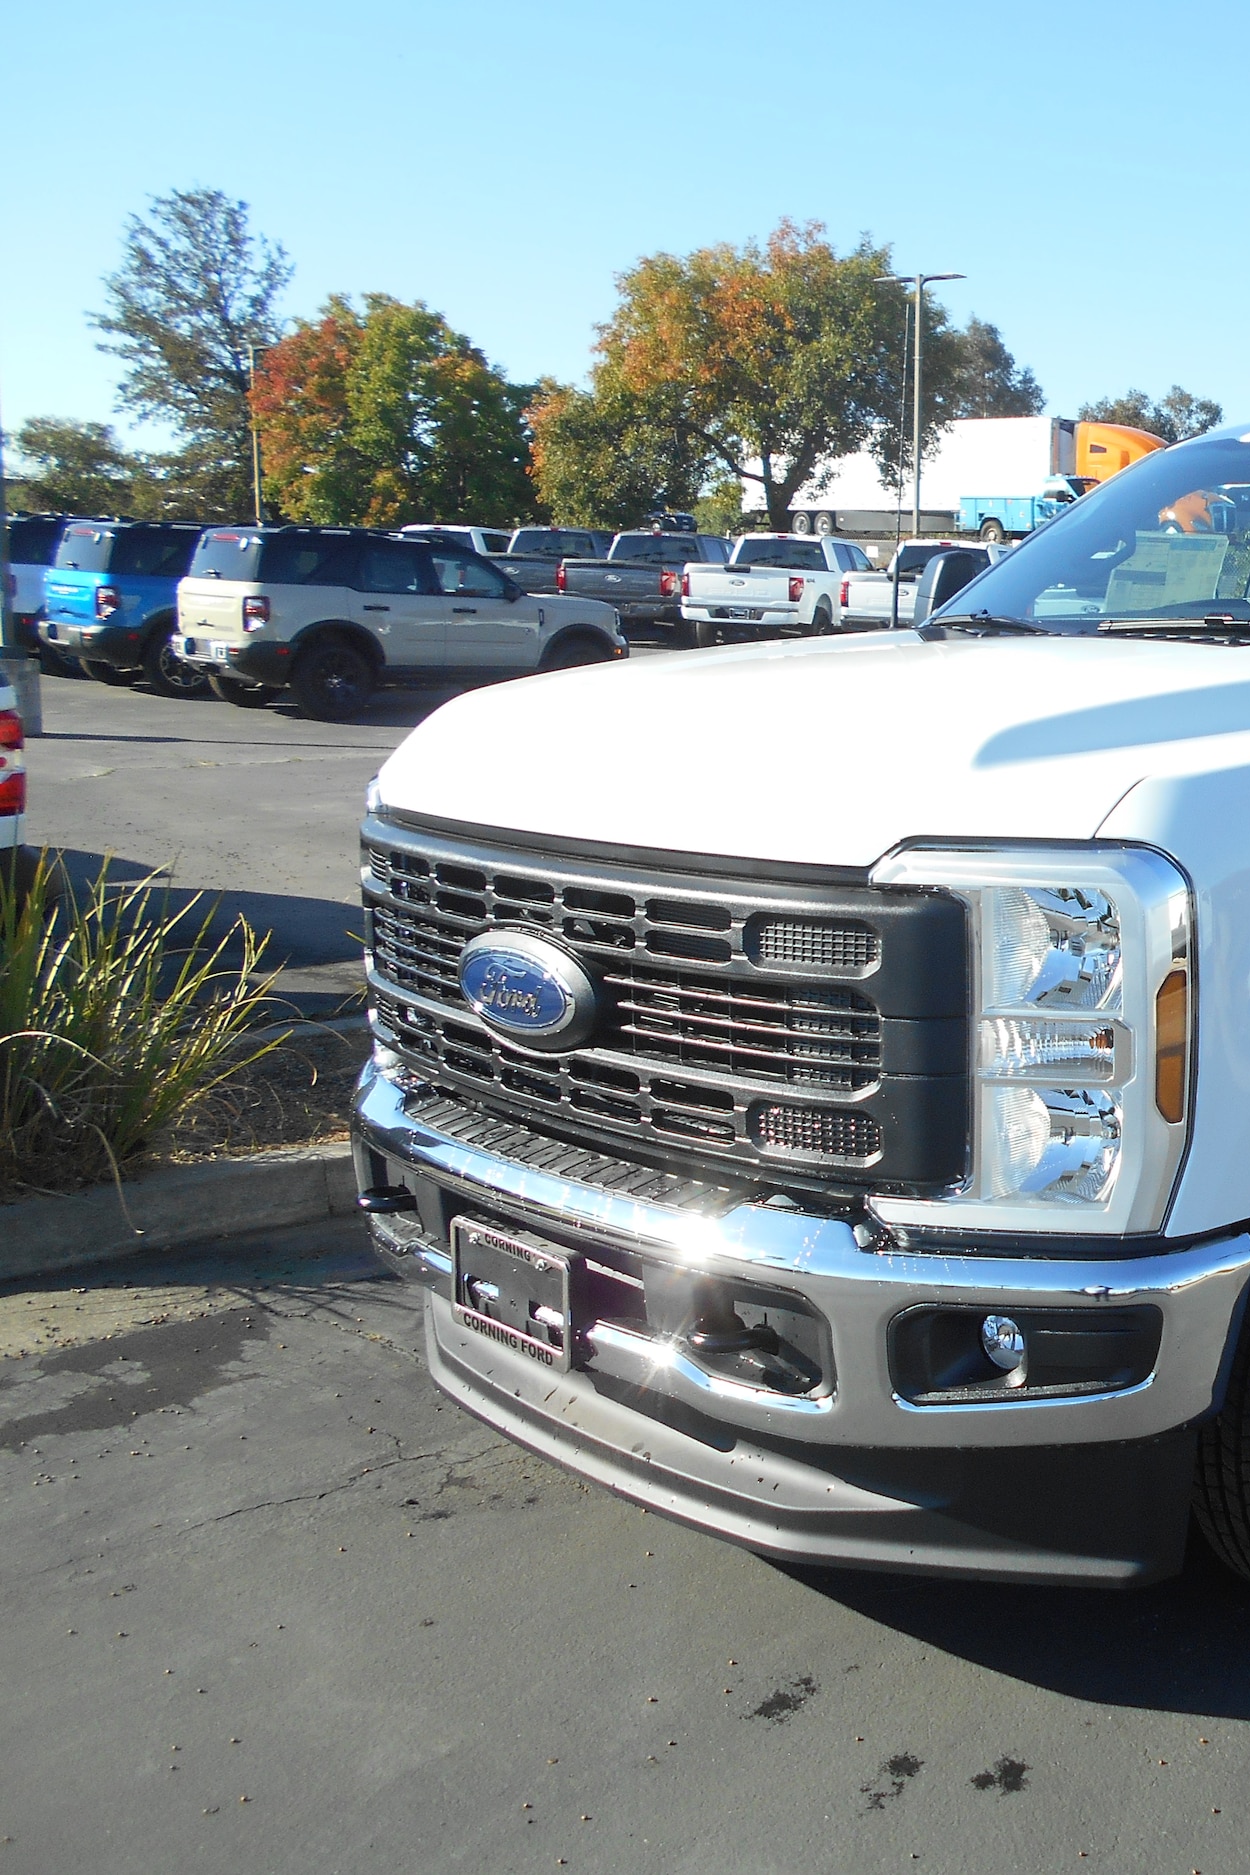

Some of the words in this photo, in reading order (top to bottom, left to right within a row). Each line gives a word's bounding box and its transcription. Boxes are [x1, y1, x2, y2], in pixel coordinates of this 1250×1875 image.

[484, 1232, 531, 1262] CORNING
[463, 1312, 518, 1349] CORNING
[520, 1342, 554, 1366] FORD
